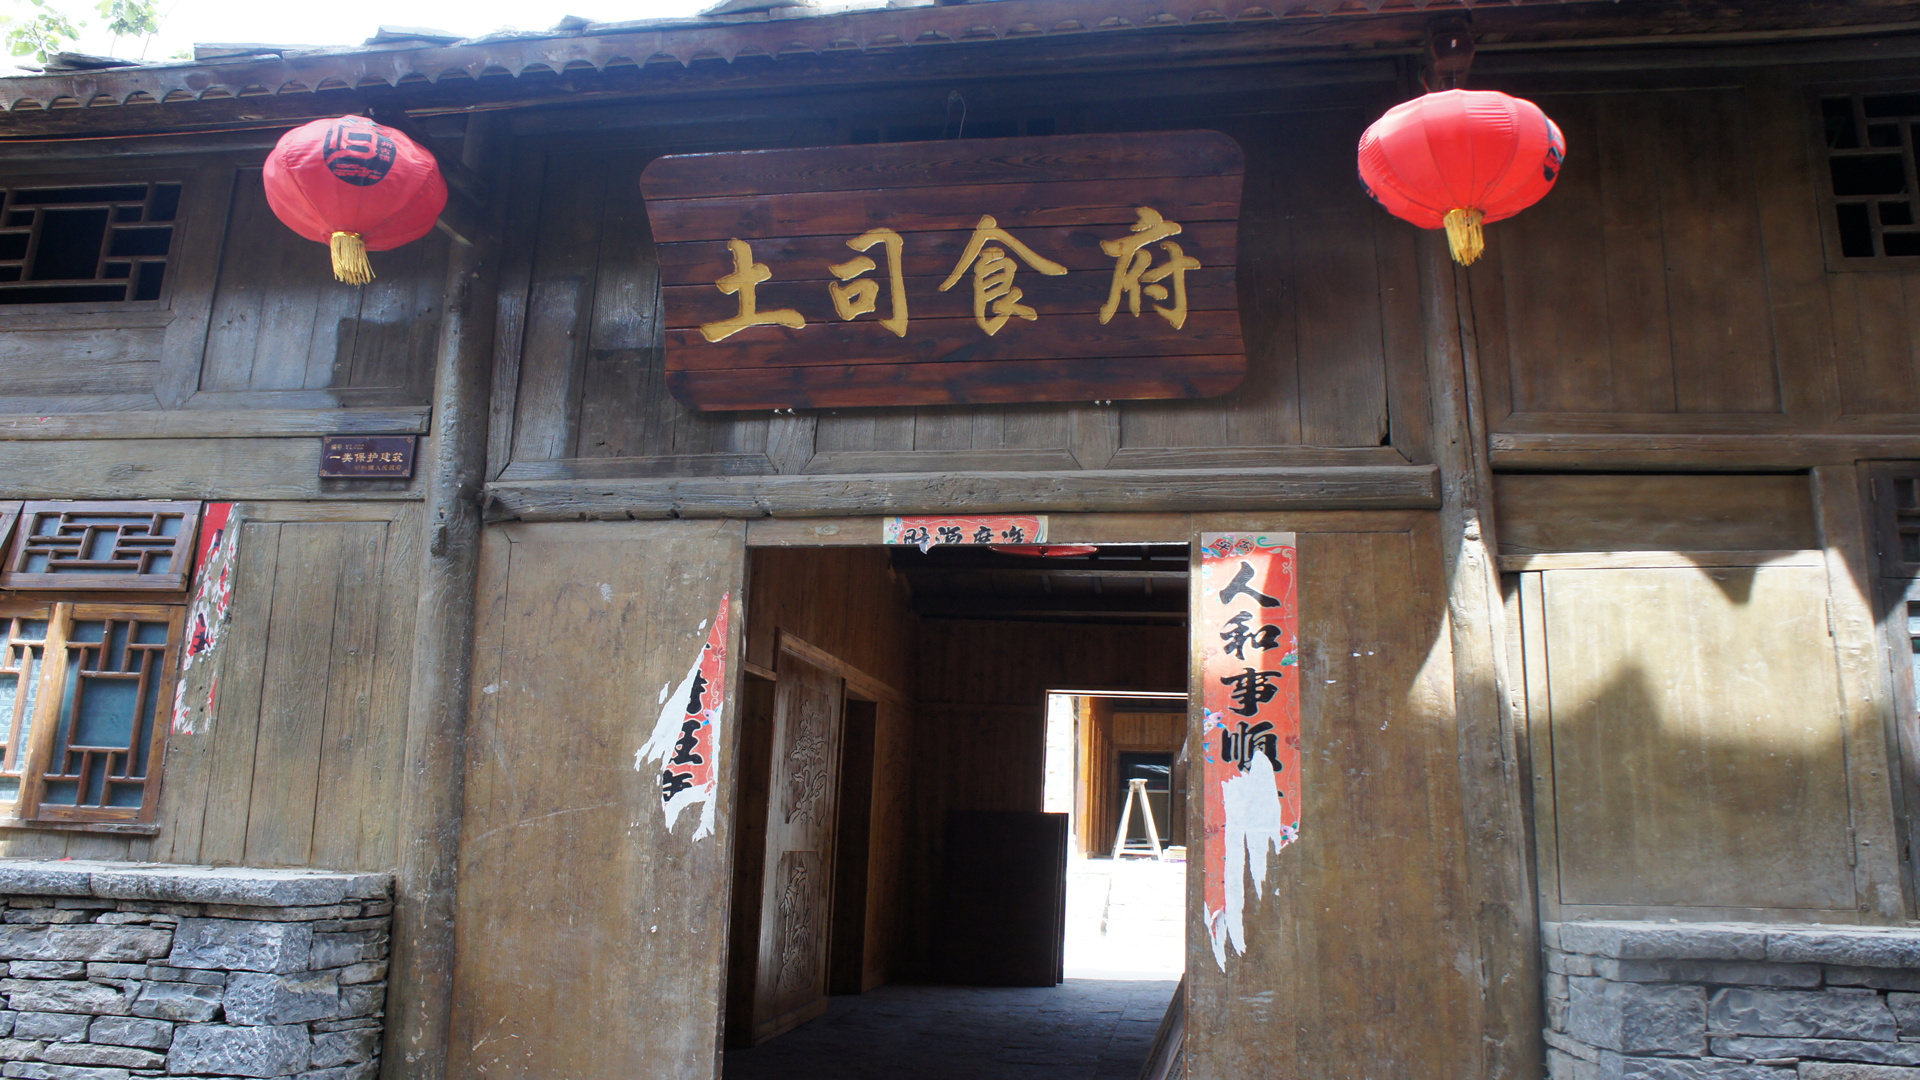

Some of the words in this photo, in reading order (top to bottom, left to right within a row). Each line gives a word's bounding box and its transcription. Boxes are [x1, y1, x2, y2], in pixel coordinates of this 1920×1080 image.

[700, 206, 1202, 343] 土司食府
[329, 452, 404, 463] 一类保护建筑
